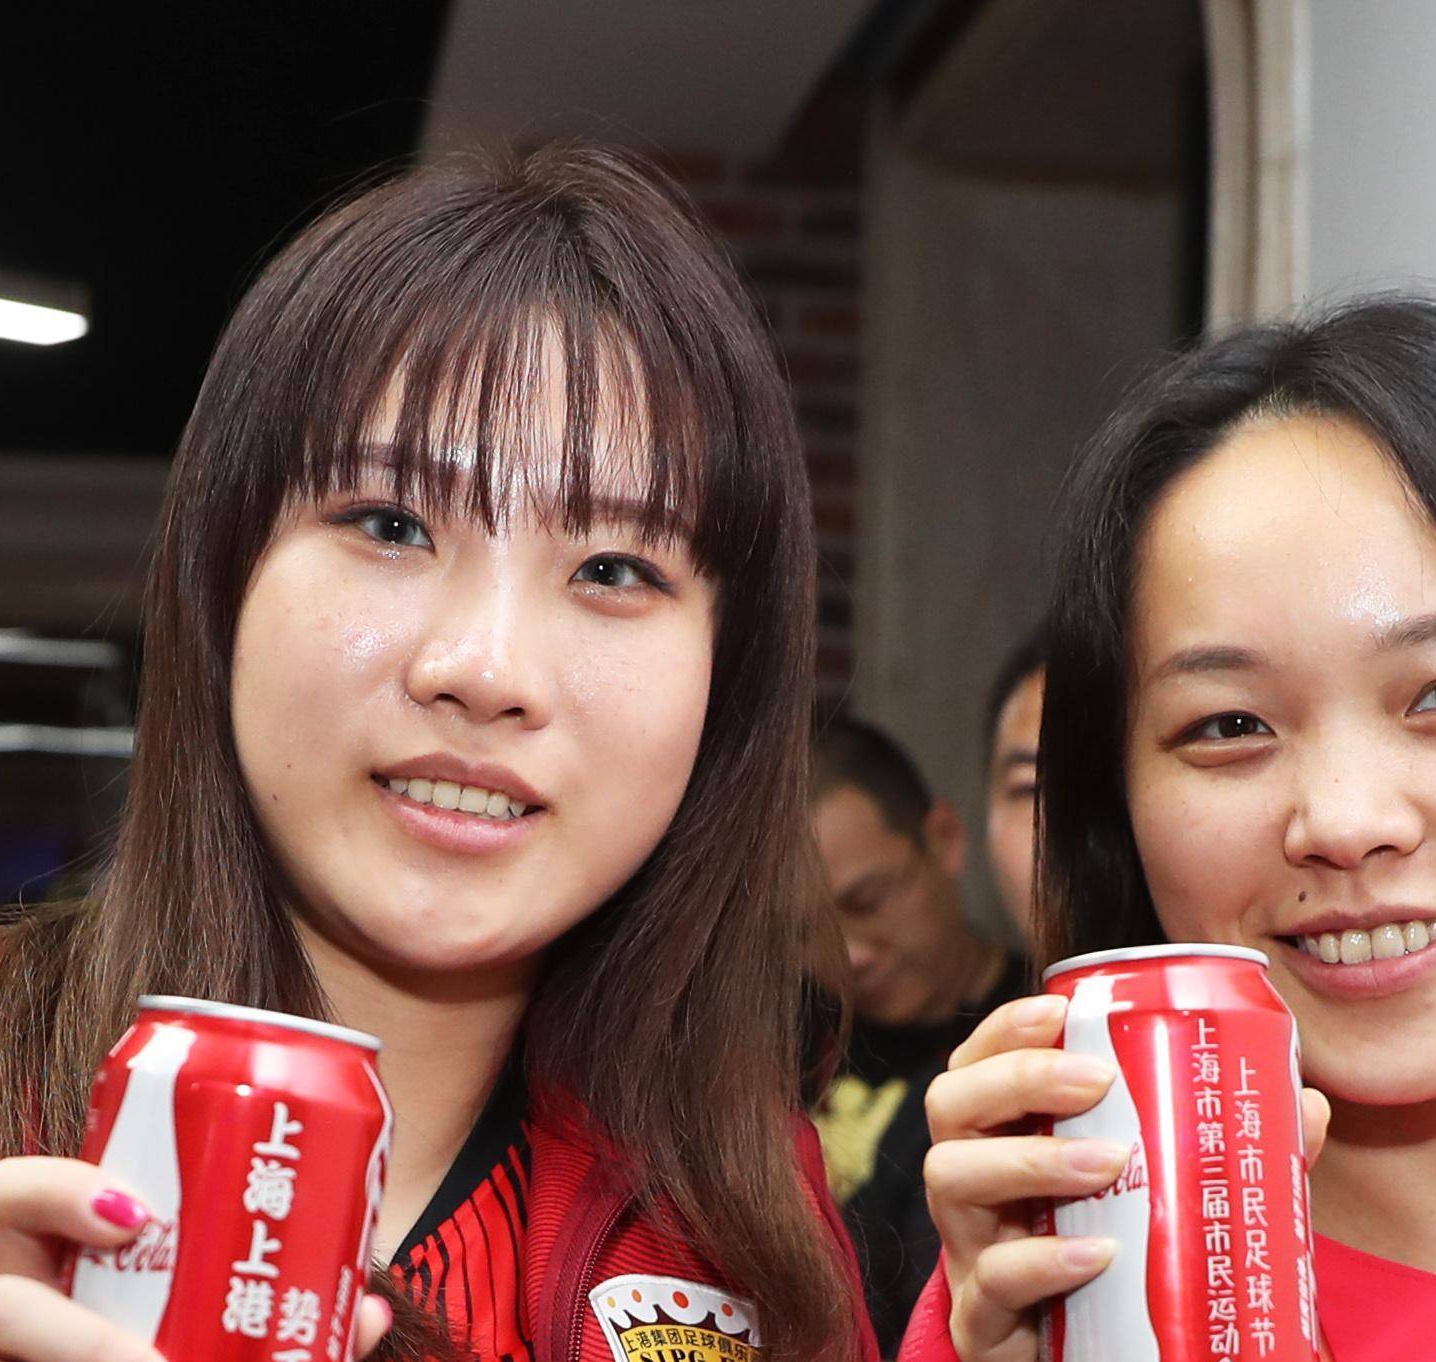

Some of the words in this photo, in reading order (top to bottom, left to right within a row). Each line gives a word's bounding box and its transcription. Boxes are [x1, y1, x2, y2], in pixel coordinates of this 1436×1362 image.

[222, 1101, 305, 1338] 上海上港
[1233, 1056, 1277, 1358] 上海市民足球节
[624, 1328, 756, 1362] 上港集团足球俱乐
